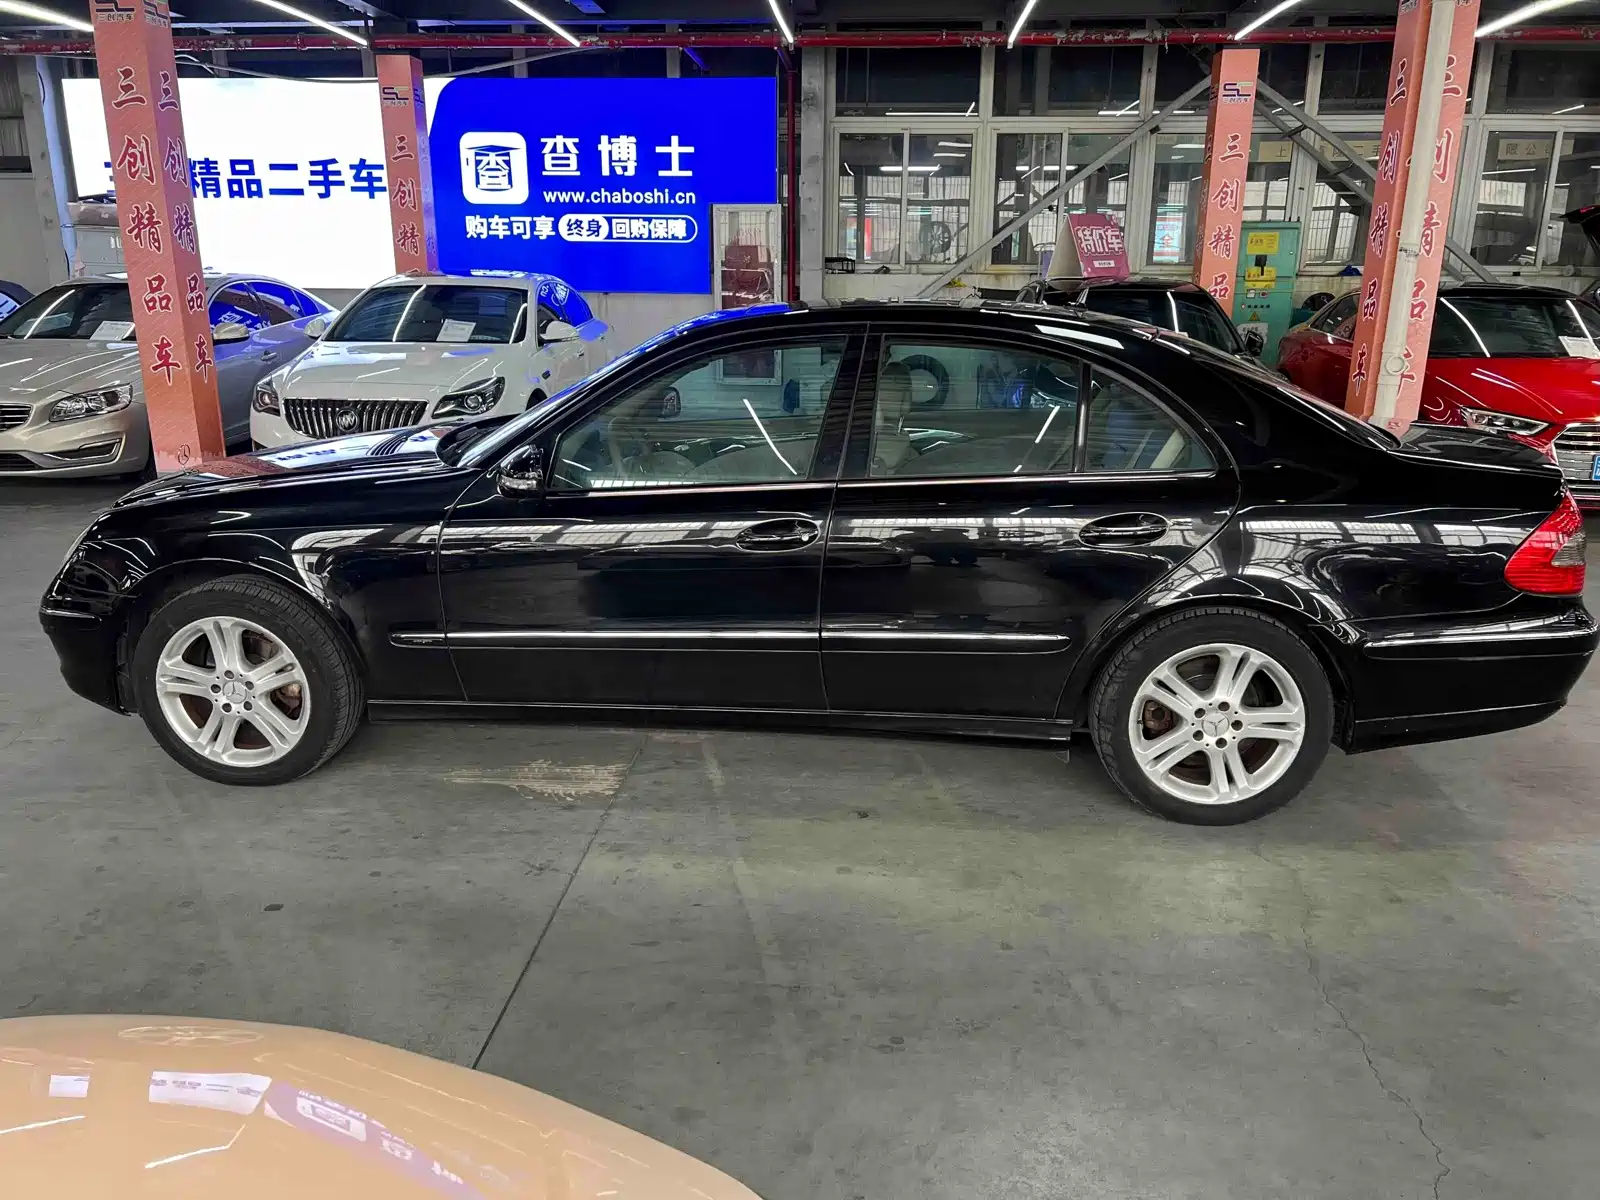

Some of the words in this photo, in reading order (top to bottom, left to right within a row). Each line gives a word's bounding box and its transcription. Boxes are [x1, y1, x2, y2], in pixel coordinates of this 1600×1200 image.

[540, 135, 695, 177] 查博士
[543, 188, 696, 204] www.chaboshi.cn
[112, 66, 183, 386] 三创精品车
[157, 70, 214, 384] 三创精品车
[391, 135, 420, 274] 三创精
[465, 215, 556, 239] 购车可享
[566, 218, 602, 238] 终身
[611, 218, 688, 240] 回购保障
[1075, 226, 1124, 255] 特价车
[1352, 58, 1407, 396] 三创精品车
